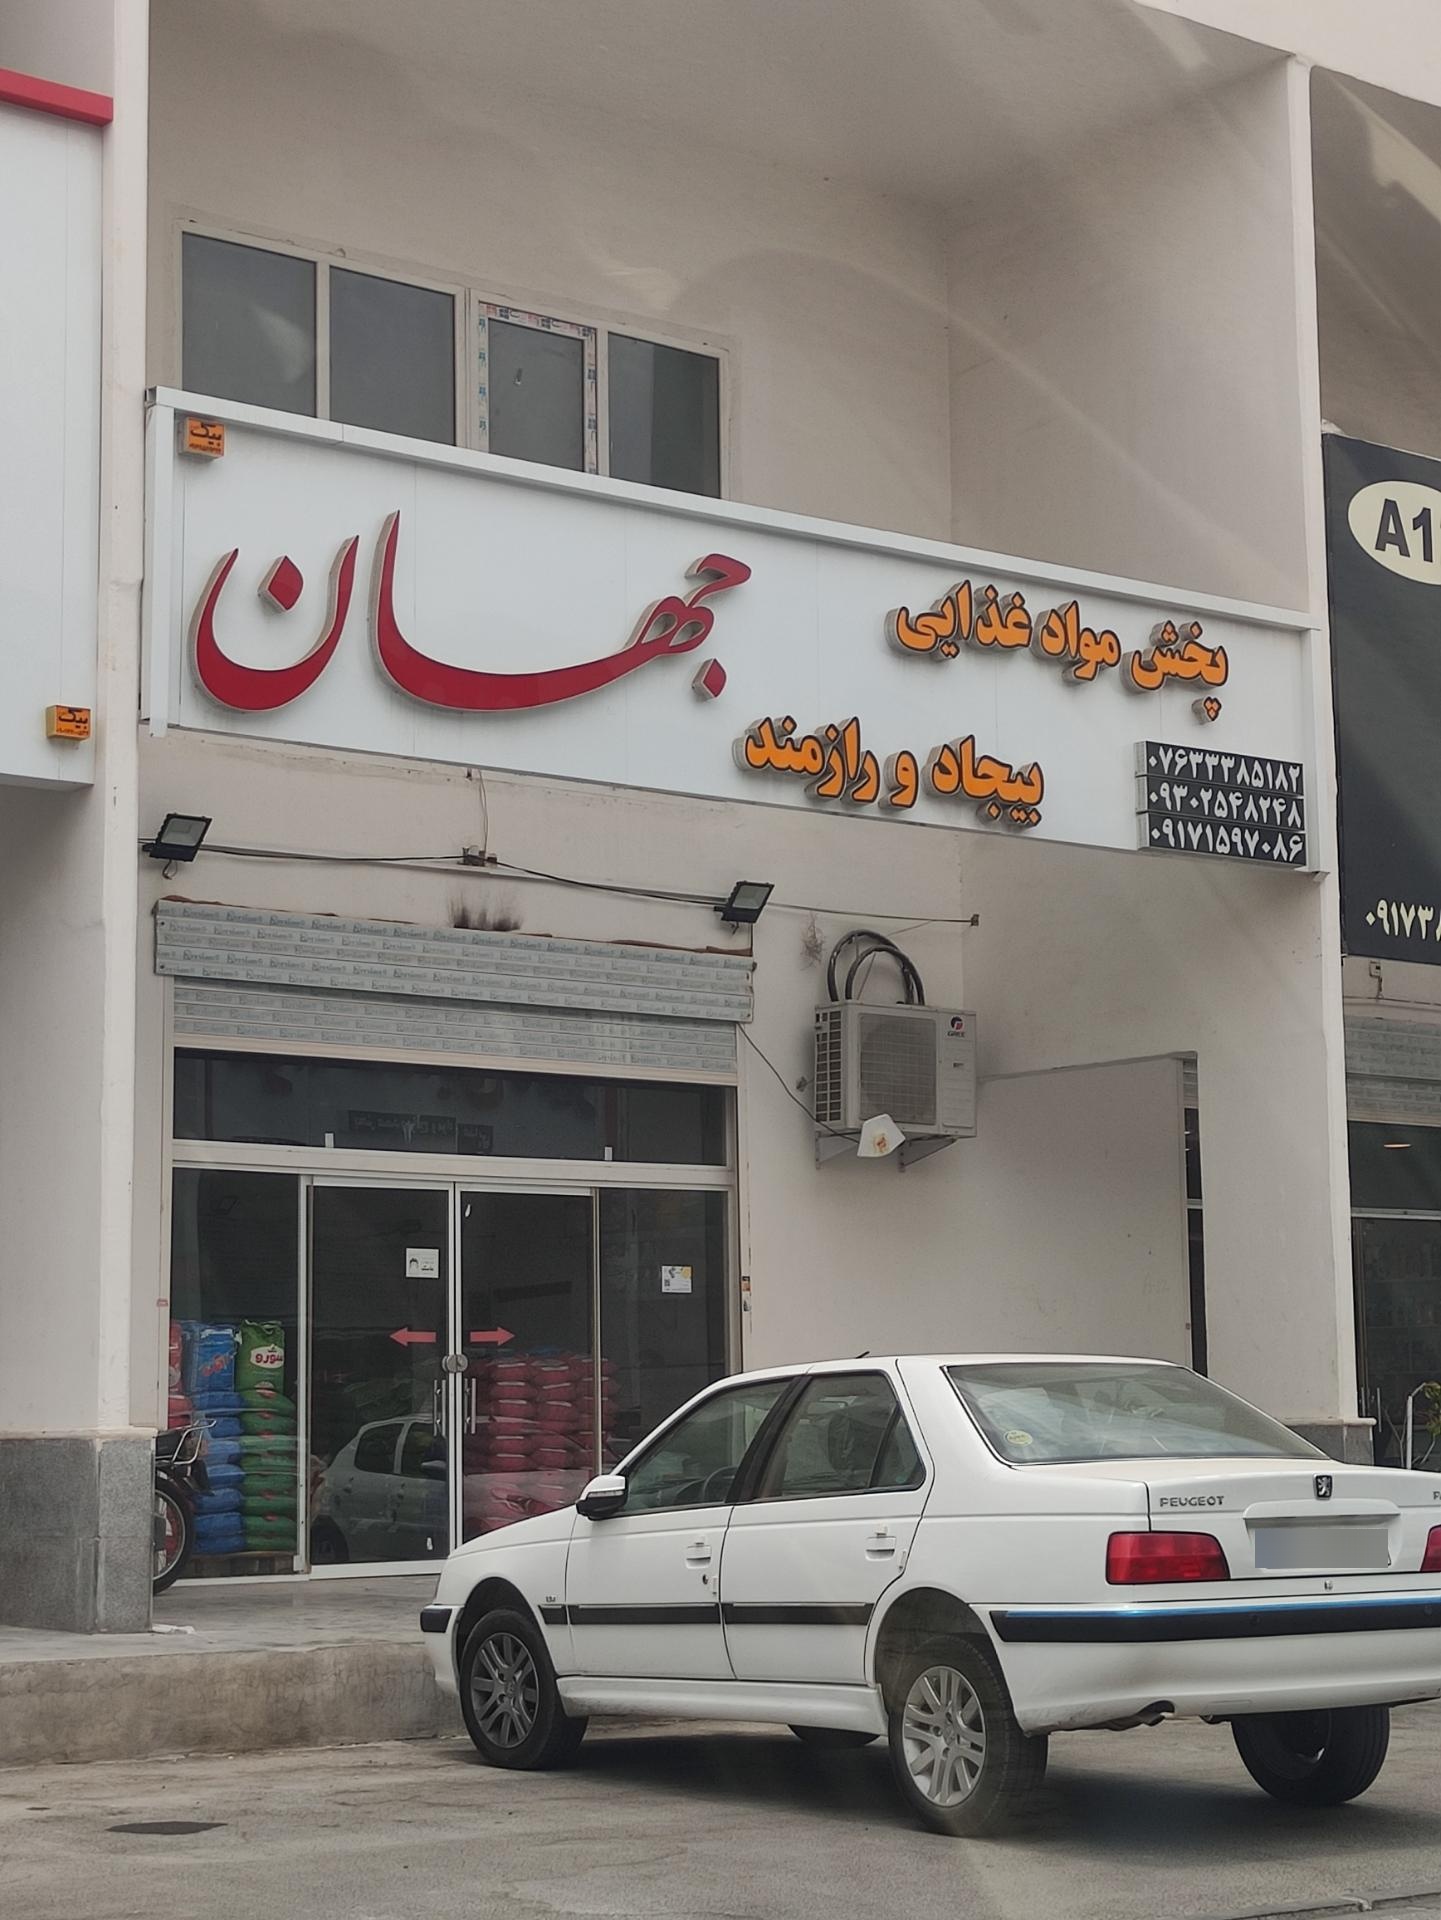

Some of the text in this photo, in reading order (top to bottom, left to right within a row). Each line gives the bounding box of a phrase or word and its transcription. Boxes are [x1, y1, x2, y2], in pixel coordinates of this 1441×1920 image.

[1374, 497, 1441, 563] A1
[196, 509, 752, 712] جهان
[895, 578, 1229, 722] پخش مواد غذایی
[744, 714, 1045, 828] بیجاد و رازمند
[1148, 745, 1301, 793] ۰۷۶۳۳۳۸۵۱۸۲
[1150, 817, 1303, 862] ۰۹۱۷۱۵۹۷۰۸۶
[1159, 1494, 1225, 1508] PEUGEOT
